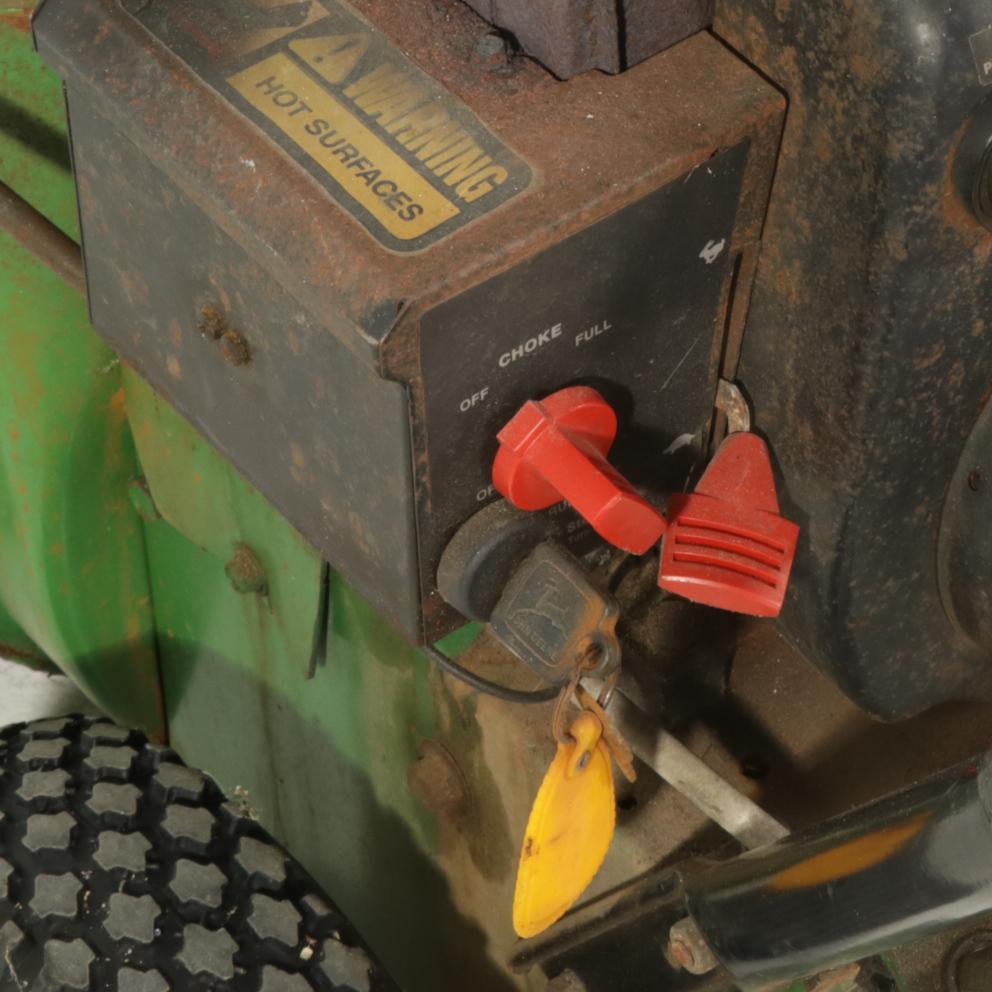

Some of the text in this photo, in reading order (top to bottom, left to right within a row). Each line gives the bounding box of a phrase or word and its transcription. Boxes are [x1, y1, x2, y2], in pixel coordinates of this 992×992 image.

[255, 75, 424, 222] HOT SURFACES
[342, 63, 508, 203] WARNING
[498, 323, 562, 367] CHOKE
[575, 320, 612, 346] FULL
[460, 387, 489, 412] OFF
